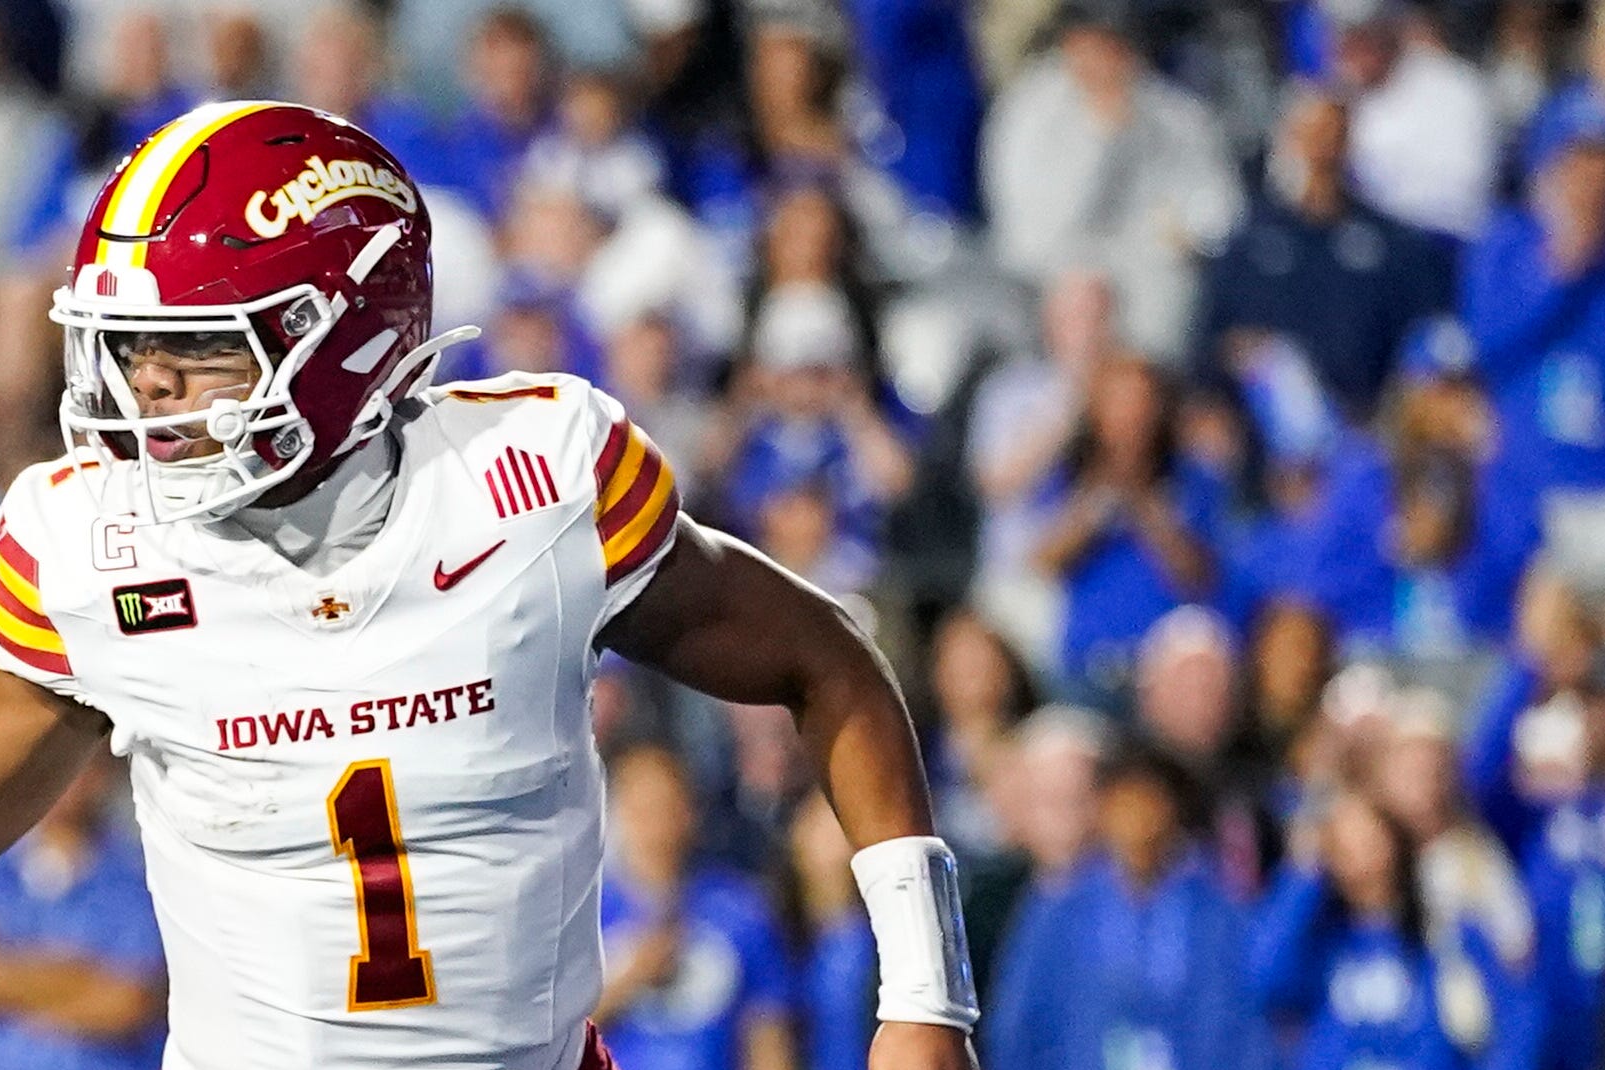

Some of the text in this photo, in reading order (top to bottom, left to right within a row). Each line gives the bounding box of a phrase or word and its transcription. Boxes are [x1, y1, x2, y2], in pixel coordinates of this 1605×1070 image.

[244, 154, 418, 239] Cyclones
[215, 677, 496, 751] IOWA STATE
[325, 757, 438, 1013] 1
